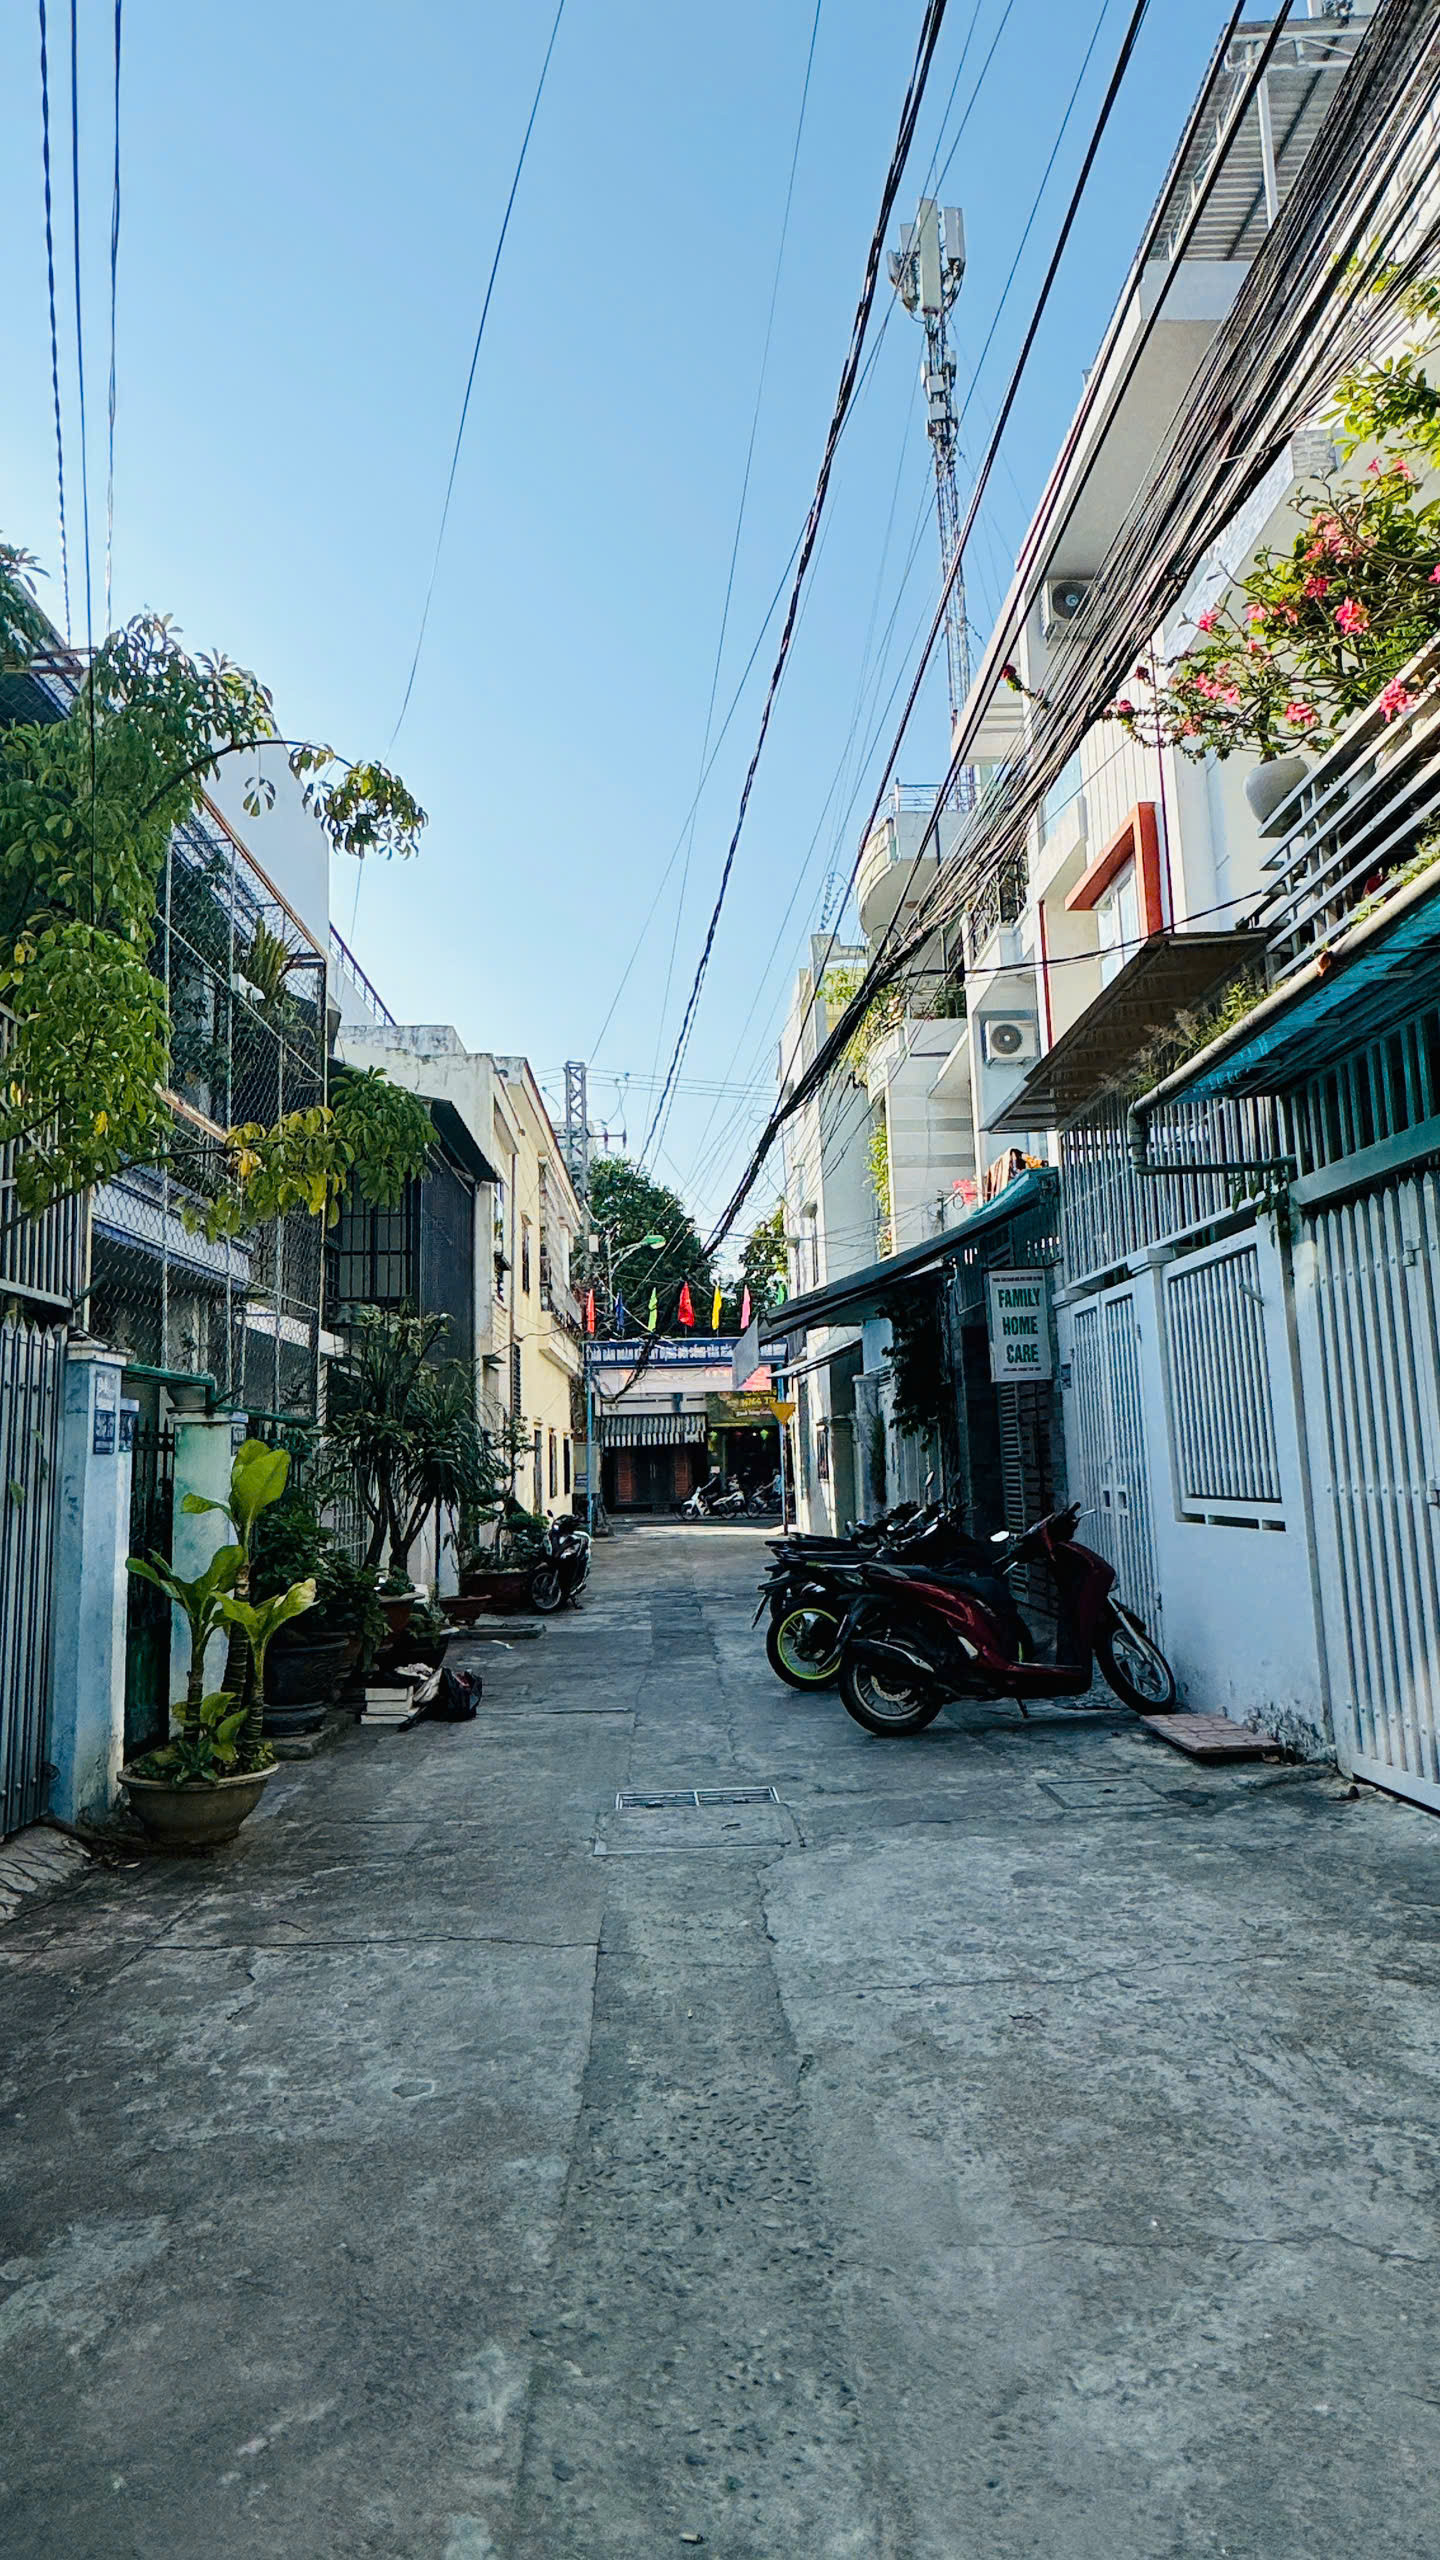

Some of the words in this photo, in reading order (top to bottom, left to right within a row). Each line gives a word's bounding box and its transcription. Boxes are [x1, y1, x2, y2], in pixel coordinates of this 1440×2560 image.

[997, 1287, 1041, 1308] FAMILY
[1001, 1316, 1039, 1336] HOME
[1006, 1343, 1040, 1364] CARE
